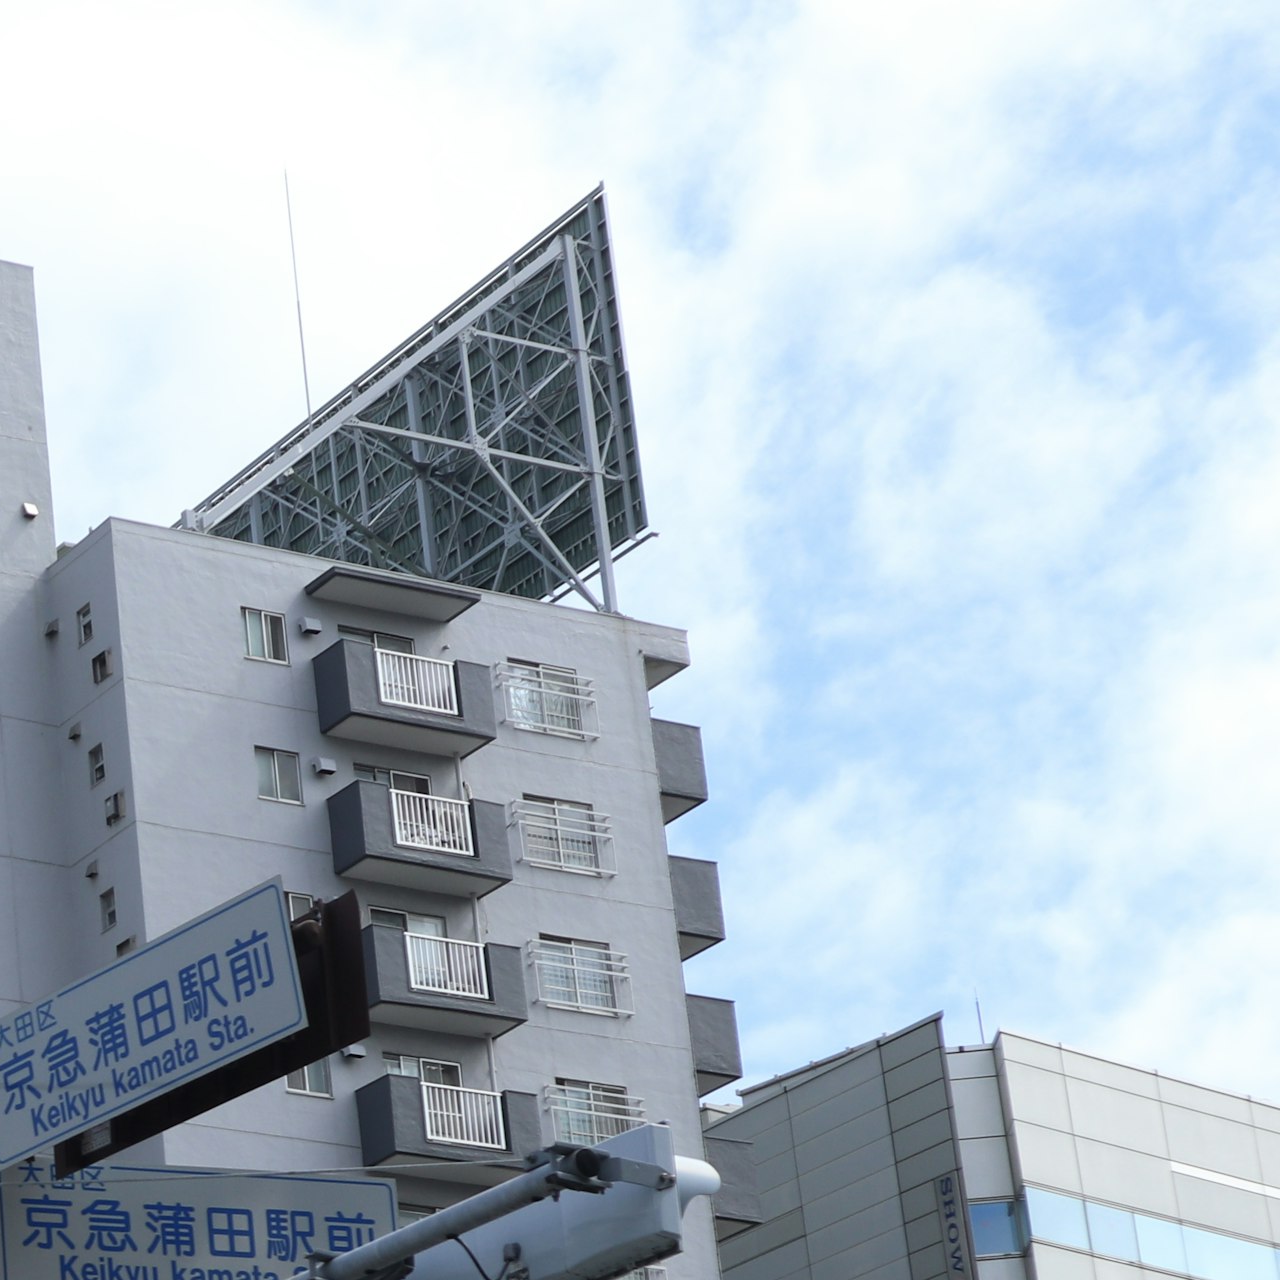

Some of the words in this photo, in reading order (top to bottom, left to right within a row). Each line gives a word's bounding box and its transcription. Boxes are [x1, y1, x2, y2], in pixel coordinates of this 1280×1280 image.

[31, 1083, 106, 1137] Keikyu
[111, 1037, 199, 1098] kamata
[207, 1014, 255, 1051] Sta.
[20, 1194, 376, 1263] 京急蒲田駅前
